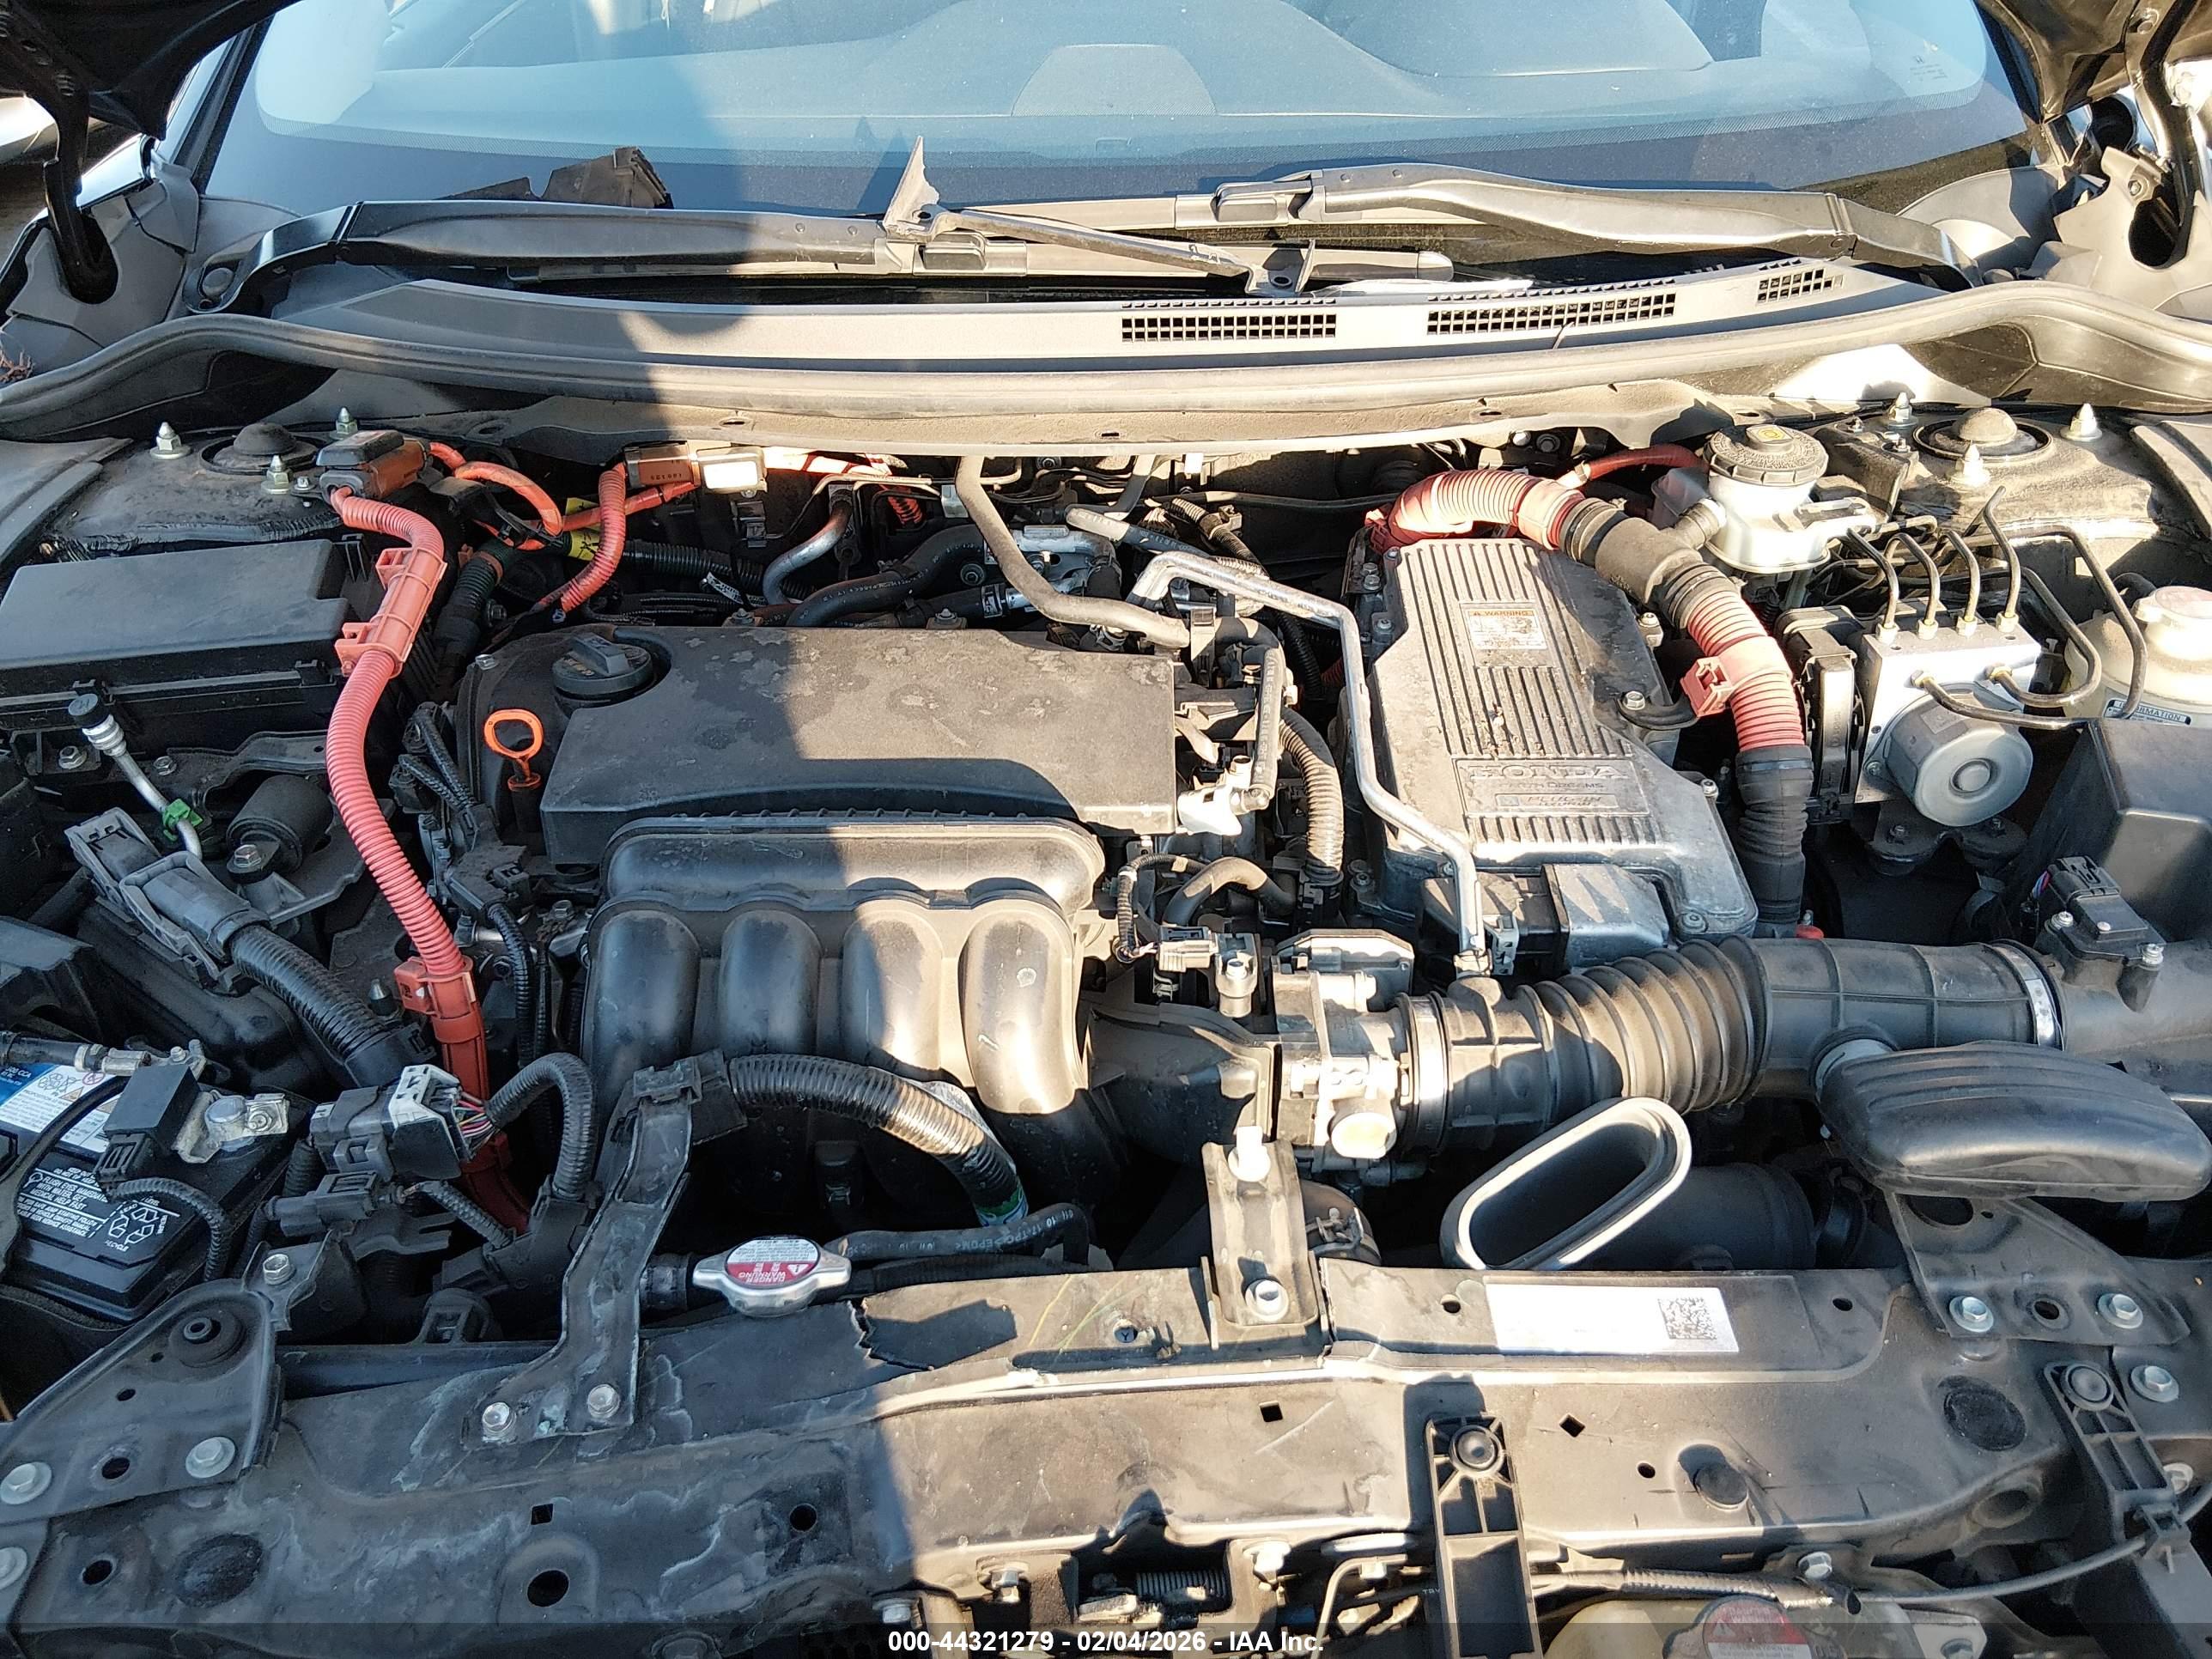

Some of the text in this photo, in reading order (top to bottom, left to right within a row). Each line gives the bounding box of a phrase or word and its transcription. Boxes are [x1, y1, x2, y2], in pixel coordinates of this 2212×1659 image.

[1468, 765, 1629, 779] HONDA
[1547, 781, 1604, 789] DREAMS
[42, 1176, 64, 1187] FLUSH
[60, 1182, 78, 1192] EYES
[35, 1182, 53, 1192] WITH
[72, 1193, 88, 1202] GET
[29, 1188, 56, 1201] MEDICAL
[53, 1196, 72, 1206] HELP
[68, 1200, 88, 1211] FAST
[738, 1270, 787, 1280] WARNUNG
[745, 1275, 786, 1285] DANGER
